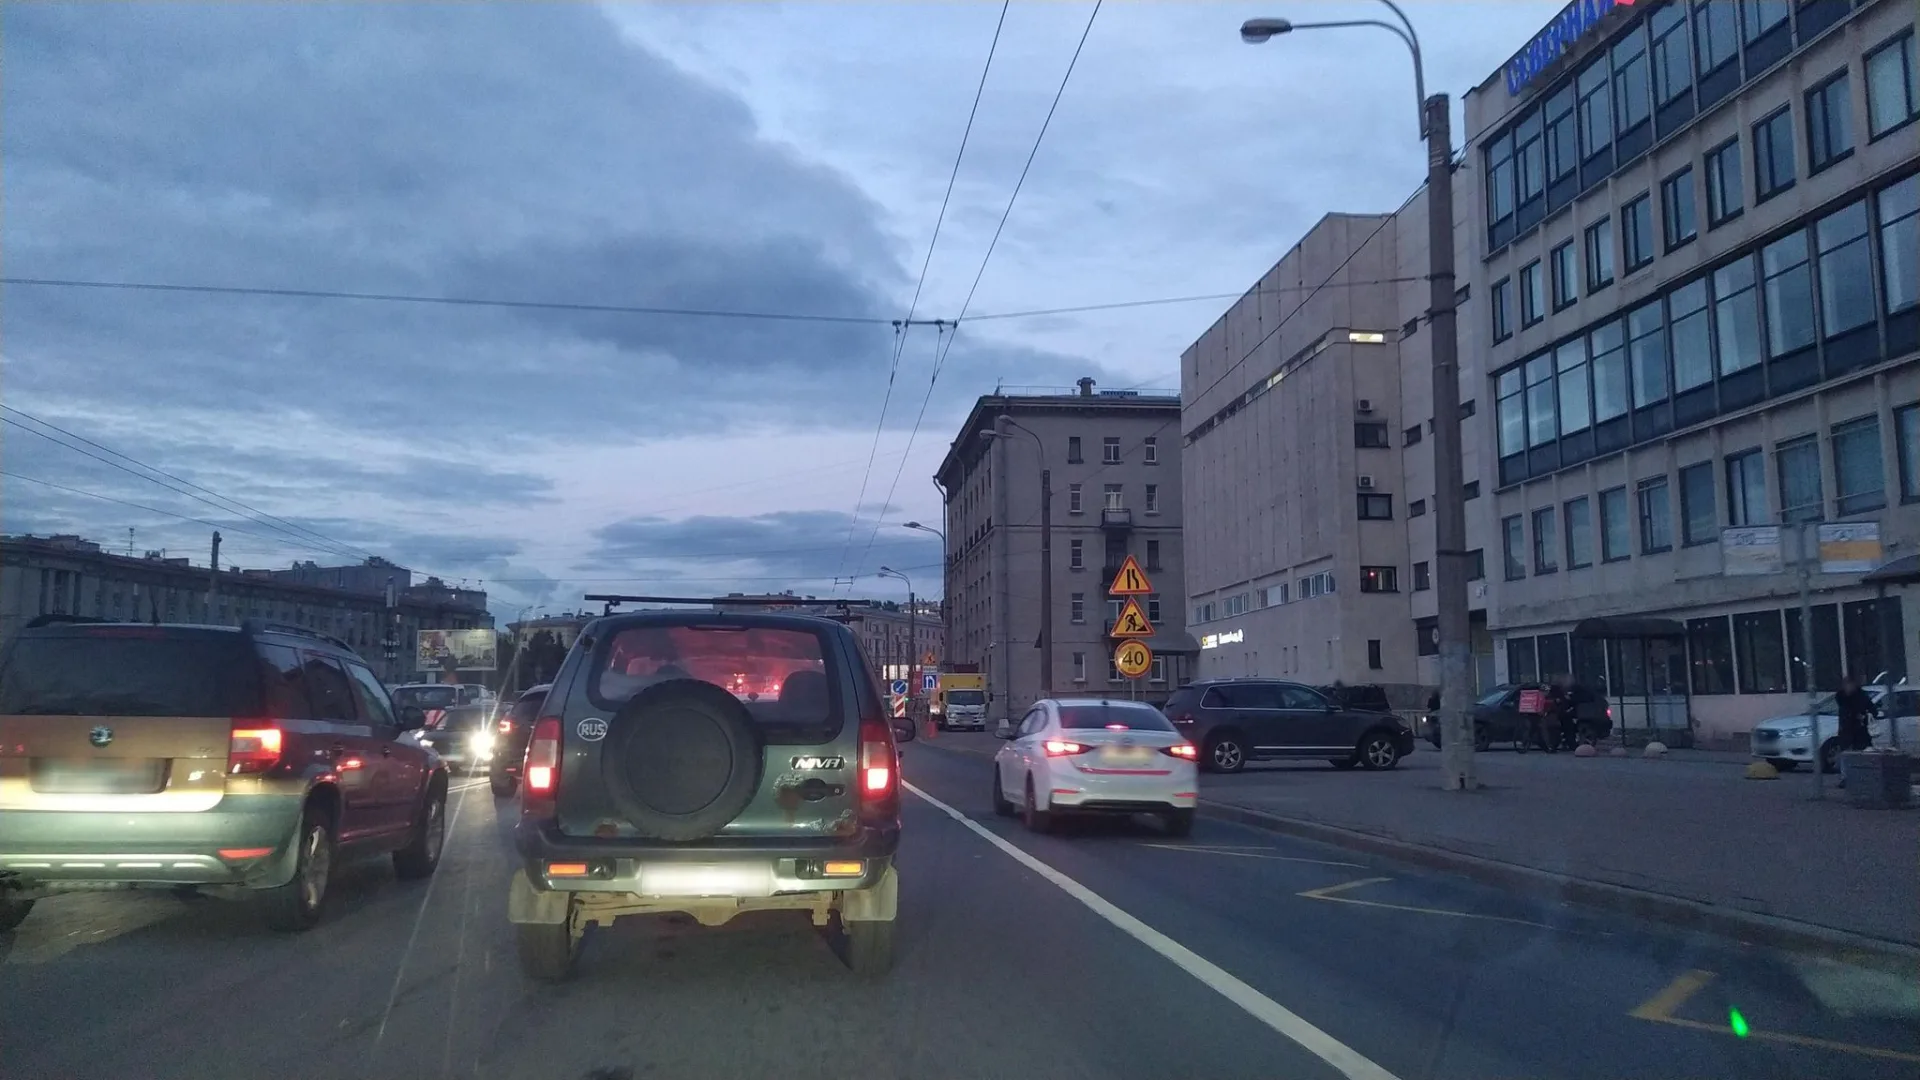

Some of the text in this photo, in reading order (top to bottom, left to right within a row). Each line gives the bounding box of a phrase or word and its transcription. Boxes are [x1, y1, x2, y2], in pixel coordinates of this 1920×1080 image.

[1122, 650, 1144, 666] 40
[581, 723, 605, 736] RUS
[795, 757, 840, 769] NIVA
